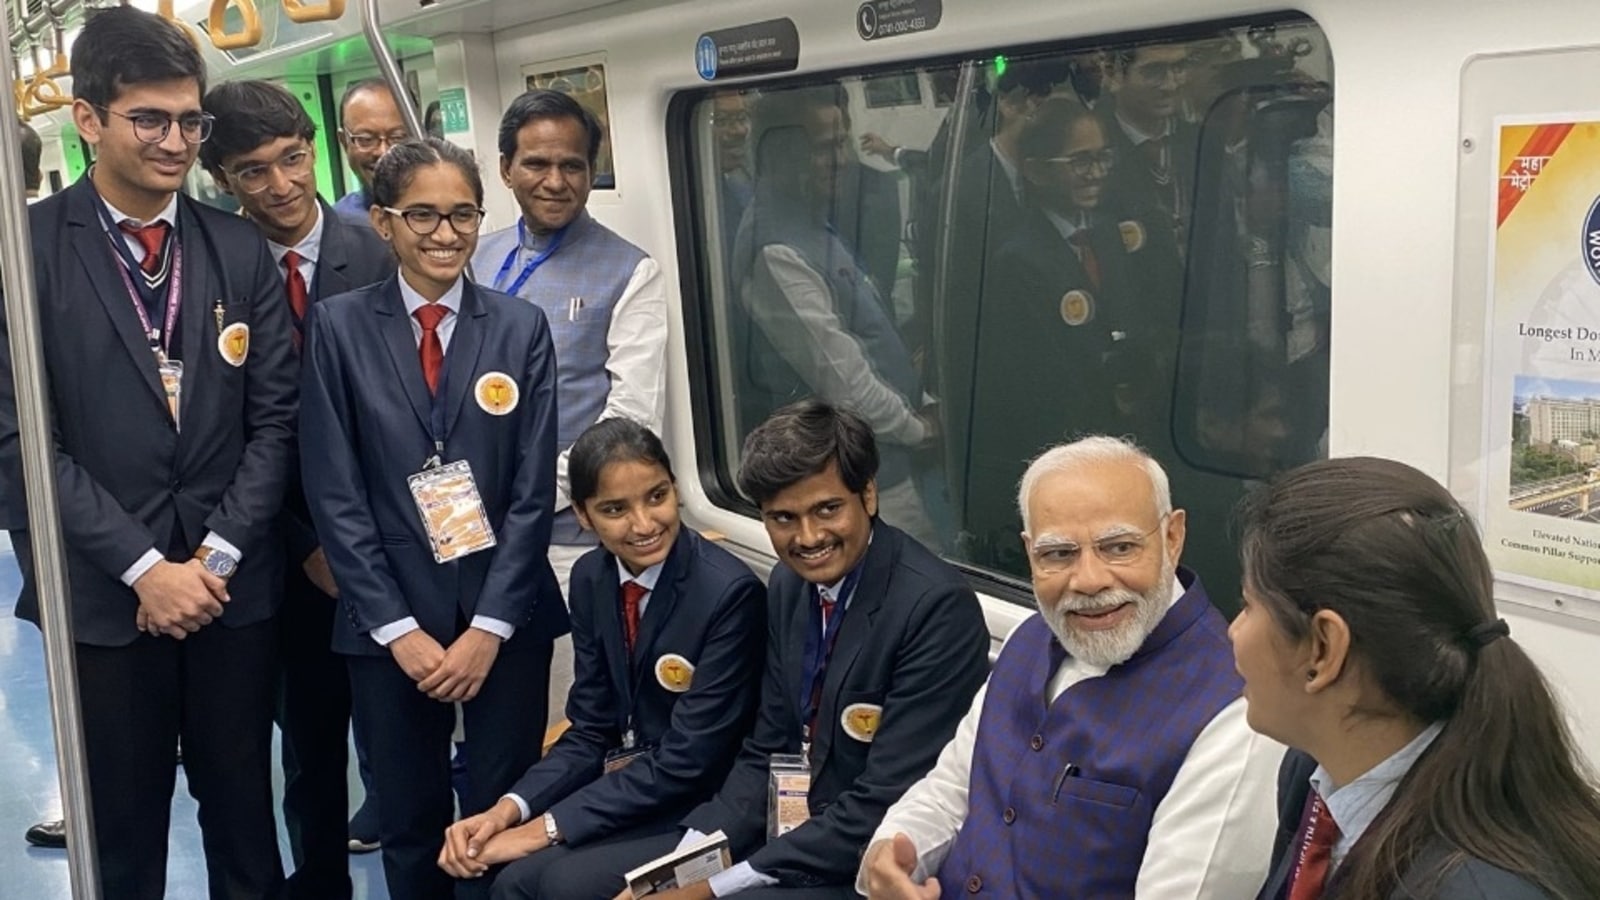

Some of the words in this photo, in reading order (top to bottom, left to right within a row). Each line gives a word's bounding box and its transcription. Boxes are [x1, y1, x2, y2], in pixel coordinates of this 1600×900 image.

[1519, 323, 1571, 342] Longest
[1577, 327, 1600, 341] Do
[1571, 347, 1585, 360] In
[1533, 529, 1571, 544] Elevated
[1573, 536, 1600, 549] Natio
[1501, 538, 1541, 553] Common
[1543, 546, 1566, 558] Pillar
[1568, 551, 1600, 565] Suppo
